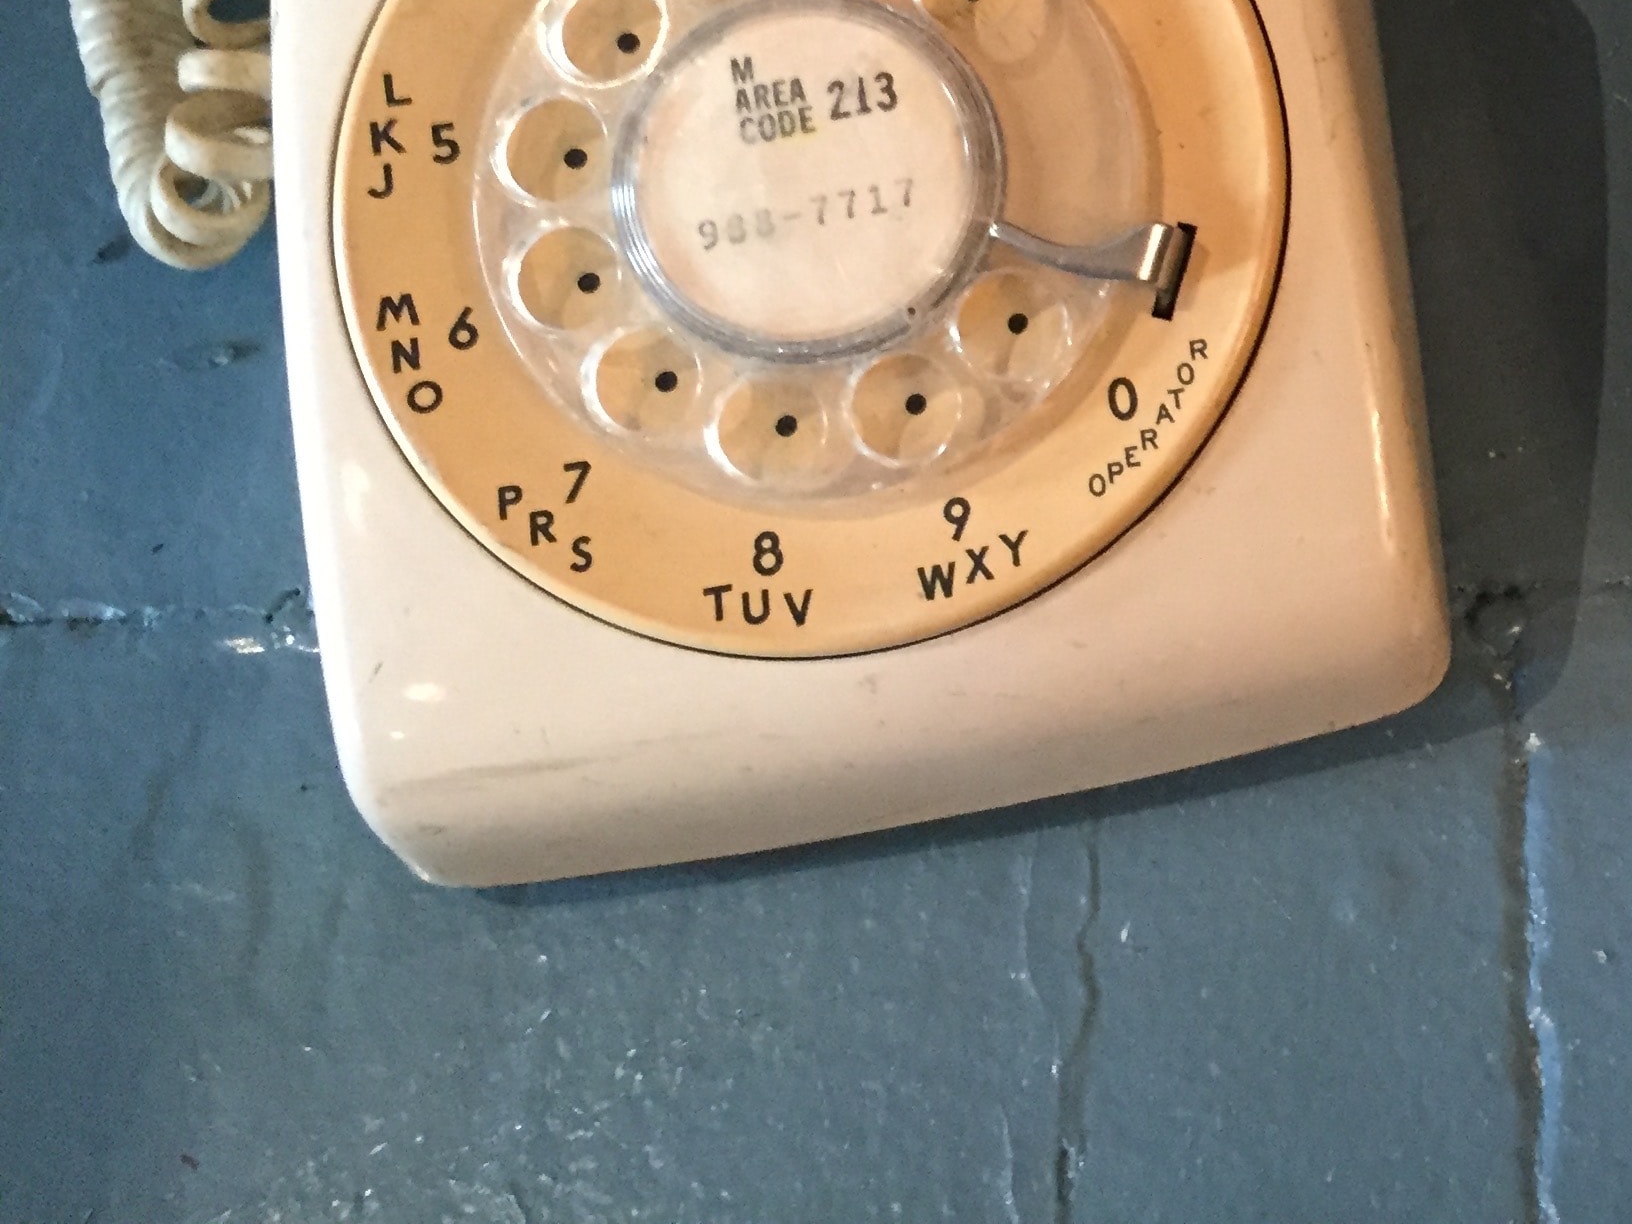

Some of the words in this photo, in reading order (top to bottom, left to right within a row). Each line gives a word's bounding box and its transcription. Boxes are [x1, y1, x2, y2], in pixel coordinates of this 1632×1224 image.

[731, 56, 754, 84] M
[735, 77, 807, 113] AREA
[827, 72, 898, 120] 213
[431, 122, 461, 164] 5
[739, 106, 816, 145] CODE
[448, 307, 478, 350] 6
[1088, 338, 1209, 497] OPERATOR
[564, 461, 591, 504] 7
[943, 497, 971, 541] 9
[752, 531, 784, 576] 8
[917, 530, 1028, 601] WXY
[703, 584, 812, 627] TUV
